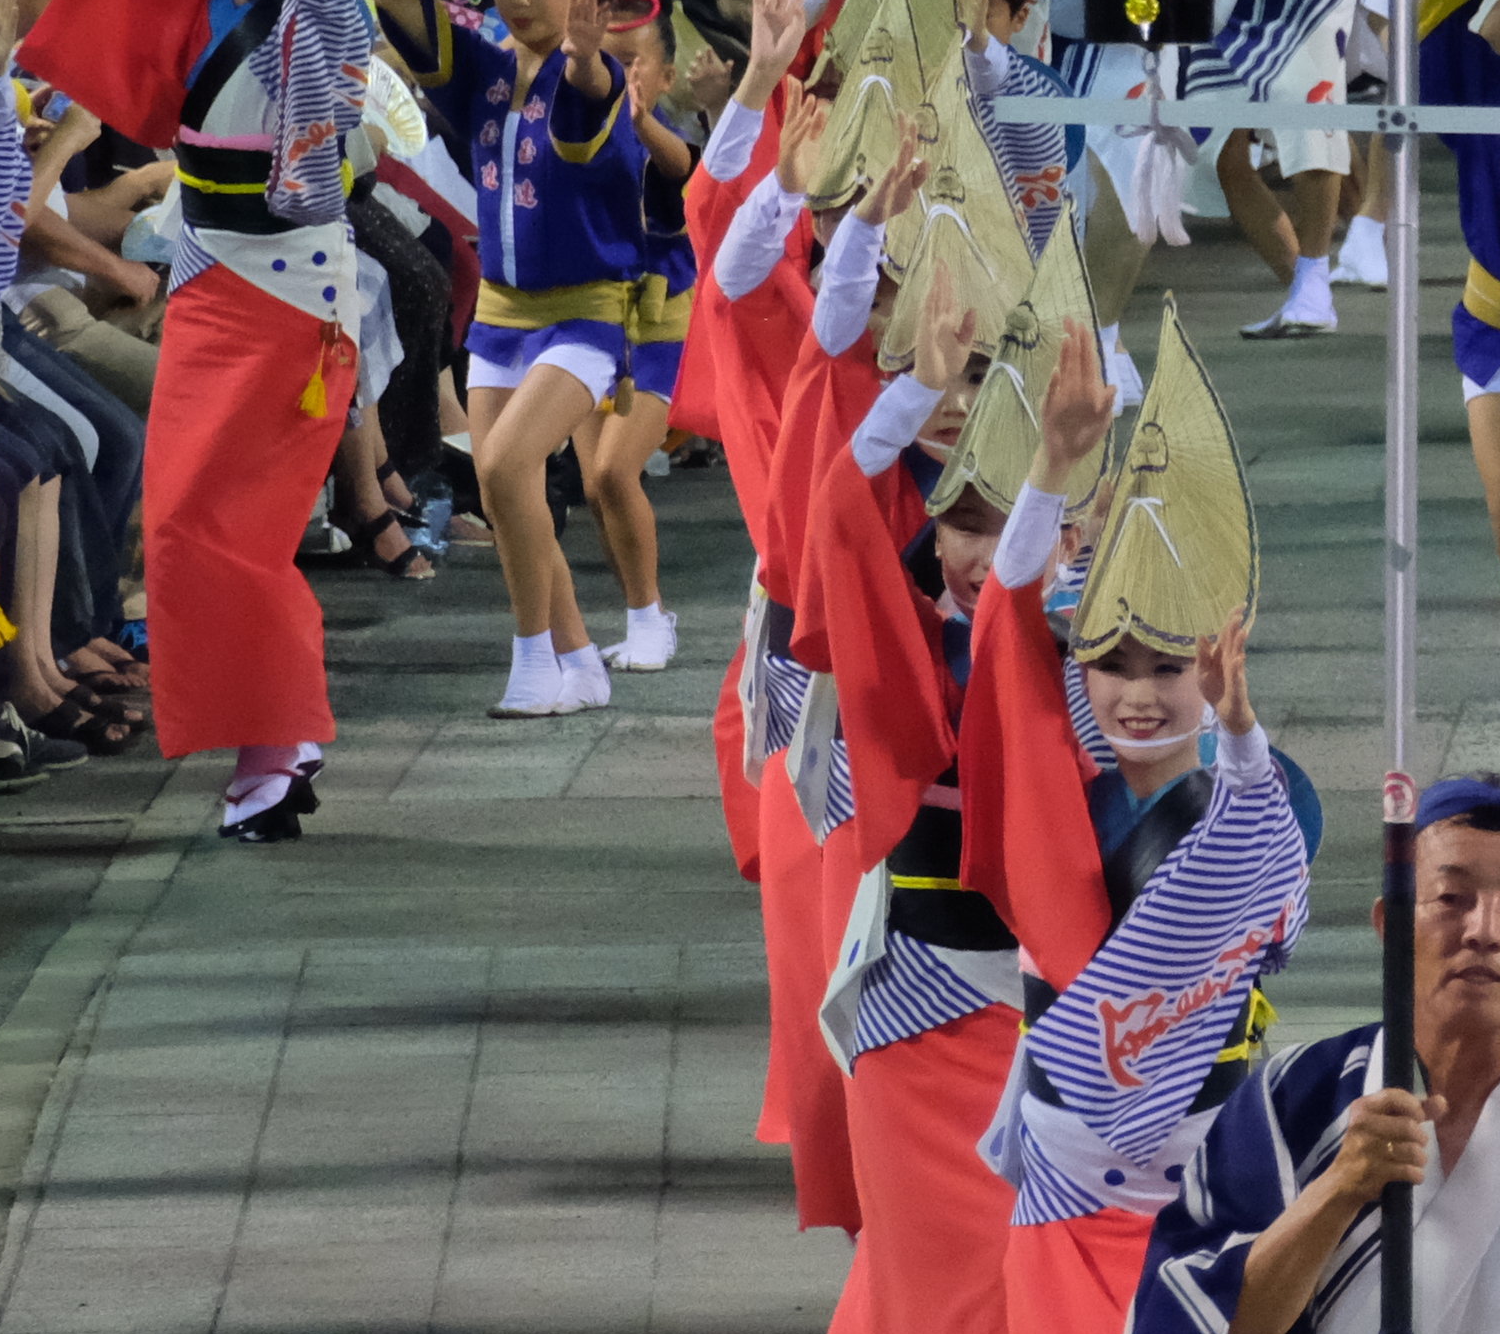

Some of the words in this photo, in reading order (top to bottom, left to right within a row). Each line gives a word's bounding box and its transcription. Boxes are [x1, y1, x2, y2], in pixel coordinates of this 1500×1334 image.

[480, 77, 511, 192] 水玉連
[513, 94, 547, 210] 水玉連
